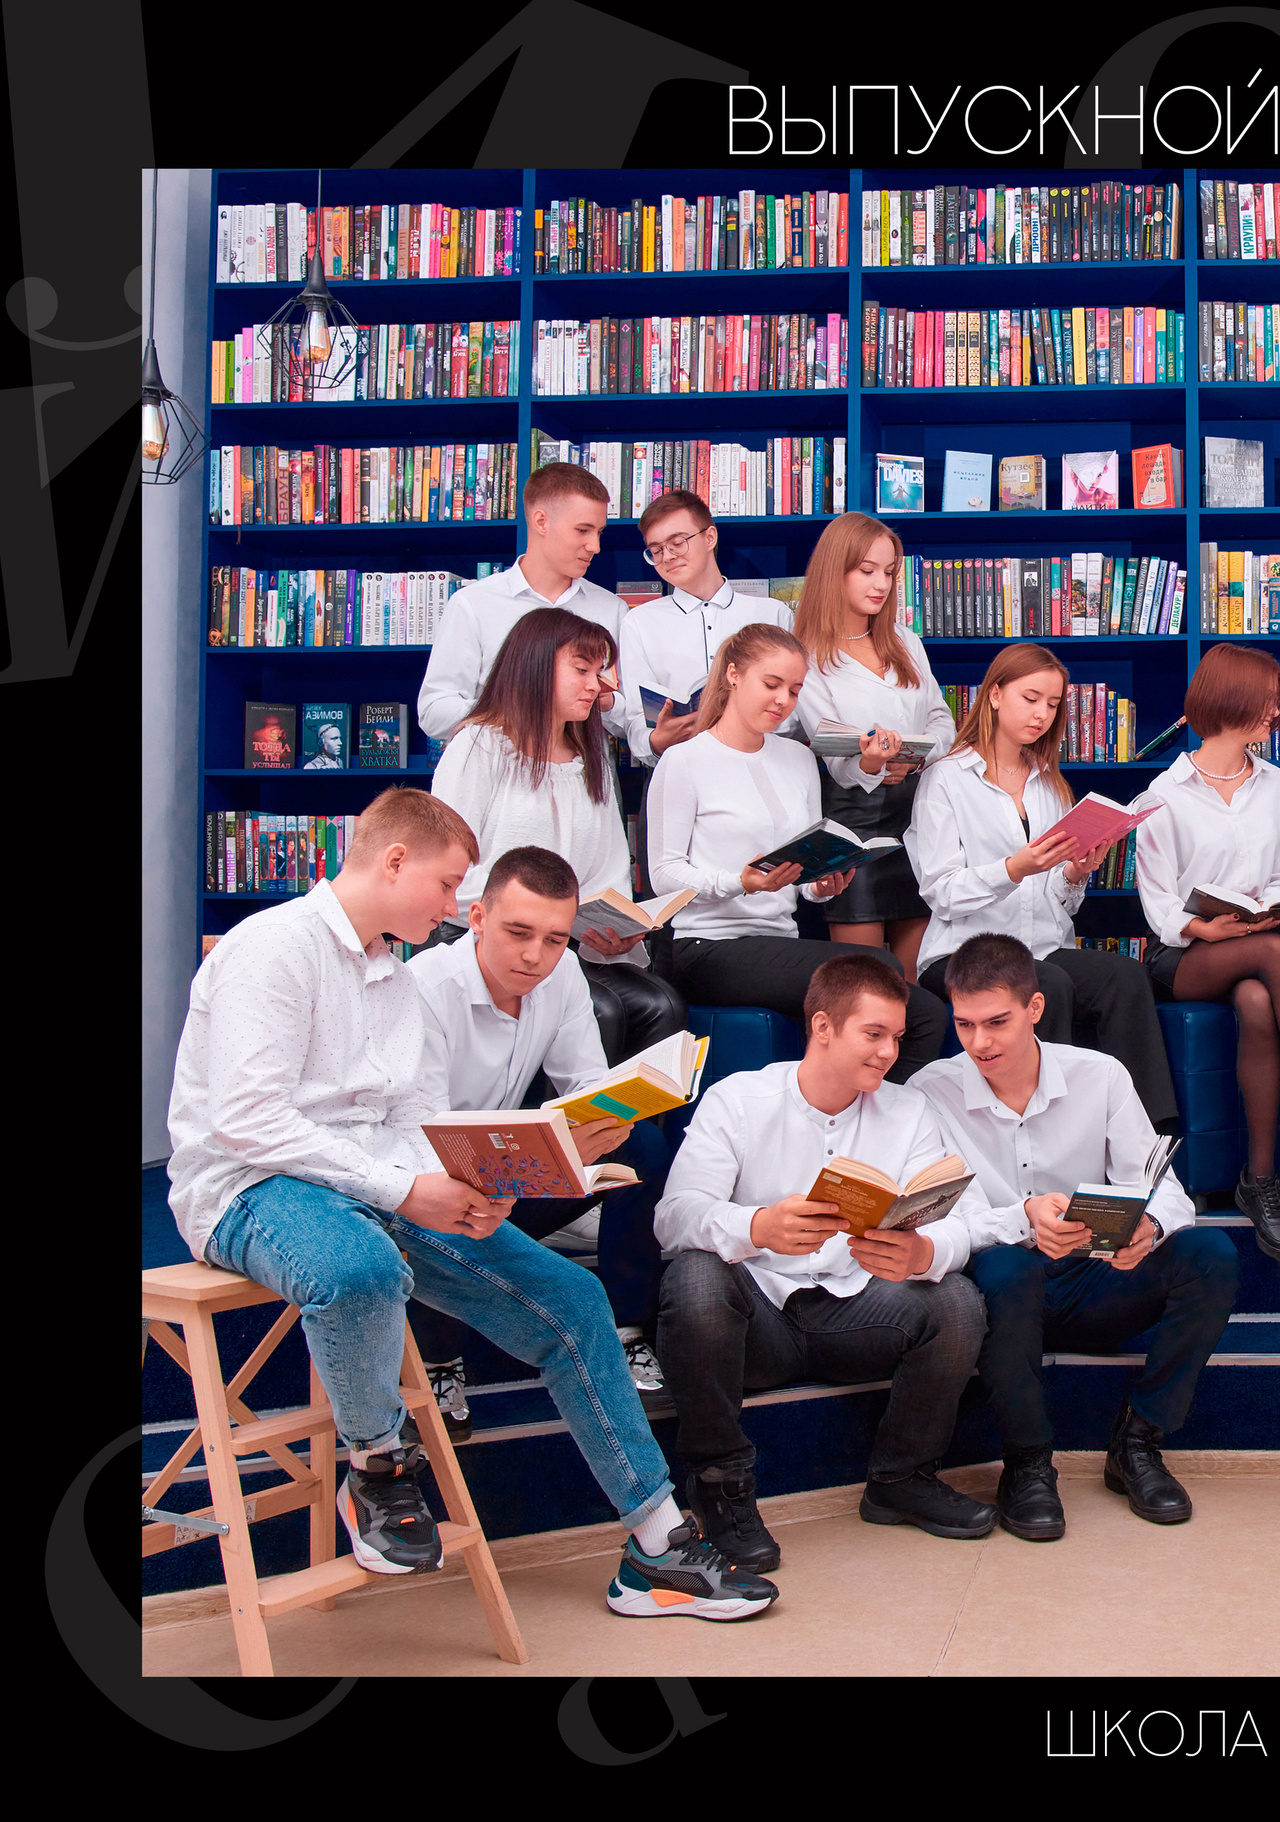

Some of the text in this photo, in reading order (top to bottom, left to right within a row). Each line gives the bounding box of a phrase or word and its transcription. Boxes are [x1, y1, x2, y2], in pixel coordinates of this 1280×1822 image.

[946, 192, 956, 231] ДАНТЕК
[1230, 203, 1239, 247] ИЗАБЕЛЬ
[1242, 218, 1254, 254] КРАУЛИ
[1064, 330, 1072, 362] КОМНАТА
[883, 467, 924, 485] DAVIES
[1001, 463, 1034, 475] Кутзее
[279, 468, 289, 523] БРАУН
[1172, 597, 1180, 628] ДЕЛАКУР
[305, 711, 344, 720] АЗИМОВ
[361, 756, 399, 767] ХВАТКА
[226, 849, 236, 883] БОННЕР
